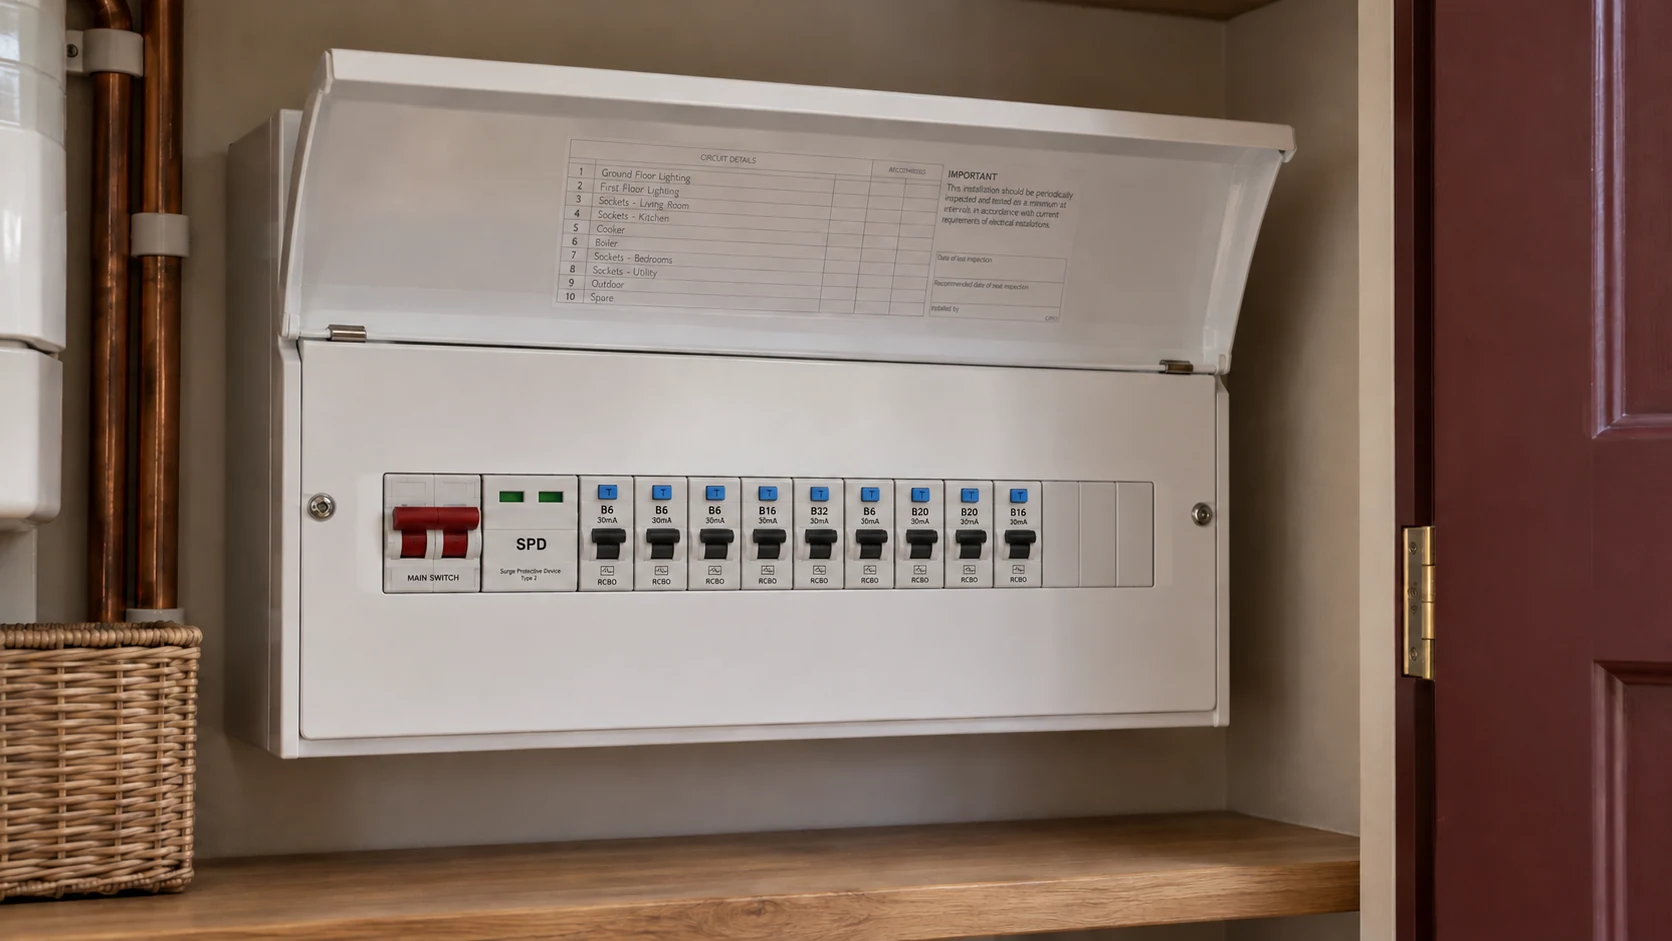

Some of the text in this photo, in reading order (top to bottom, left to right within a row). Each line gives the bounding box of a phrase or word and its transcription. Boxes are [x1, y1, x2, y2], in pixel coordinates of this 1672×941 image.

[701, 154, 757, 165] CIRCUIT DETAILS
[579, 168, 691, 185] 1 Ground Floor Lighting
[948, 170, 998, 180] IMPORTANT
[578, 182, 680, 198] 2 First Floor Lighting
[947, 183, 960, 192] This
[1002, 187, 1023, 196] should
[1026, 188, 1034, 196] be
[1036, 190, 1074, 200] periodically
[576, 195, 582, 203] 3
[599, 196, 629, 207] Sockets
[640, 201, 663, 211] Living
[668, 201, 689, 209] Room
[978, 196, 991, 204] and
[575, 209, 580, 217] 4
[598, 210, 628, 221] Sockets
[639, 213, 670, 222] Kitchen
[1021, 208, 1034, 217] with
[982, 217, 988, 225] of
[573, 224, 625, 234] 5 Cooker
[572, 237, 618, 247] 6 Boiler
[571, 251, 577, 259] 7
[595, 252, 624, 262] Sockets
[635, 254, 672, 264] Bedrooms
[570, 265, 575, 273] 8
[593, 266, 623, 276] Sockets
[569, 279, 624, 289] 9 Outdoor
[591, 293, 614, 304] Spare
[601, 506, 614, 514] B6
[656, 506, 668, 514] B6
[709, 506, 721, 514] B6
[759, 507, 776, 515] B16
[811, 507, 828, 515] B32
[864, 507, 876, 515] B6
[912, 508, 929, 516] B20
[961, 508, 978, 516] B20
[1011, 508, 1026, 516] B16
[516, 538, 547, 551] SPD
